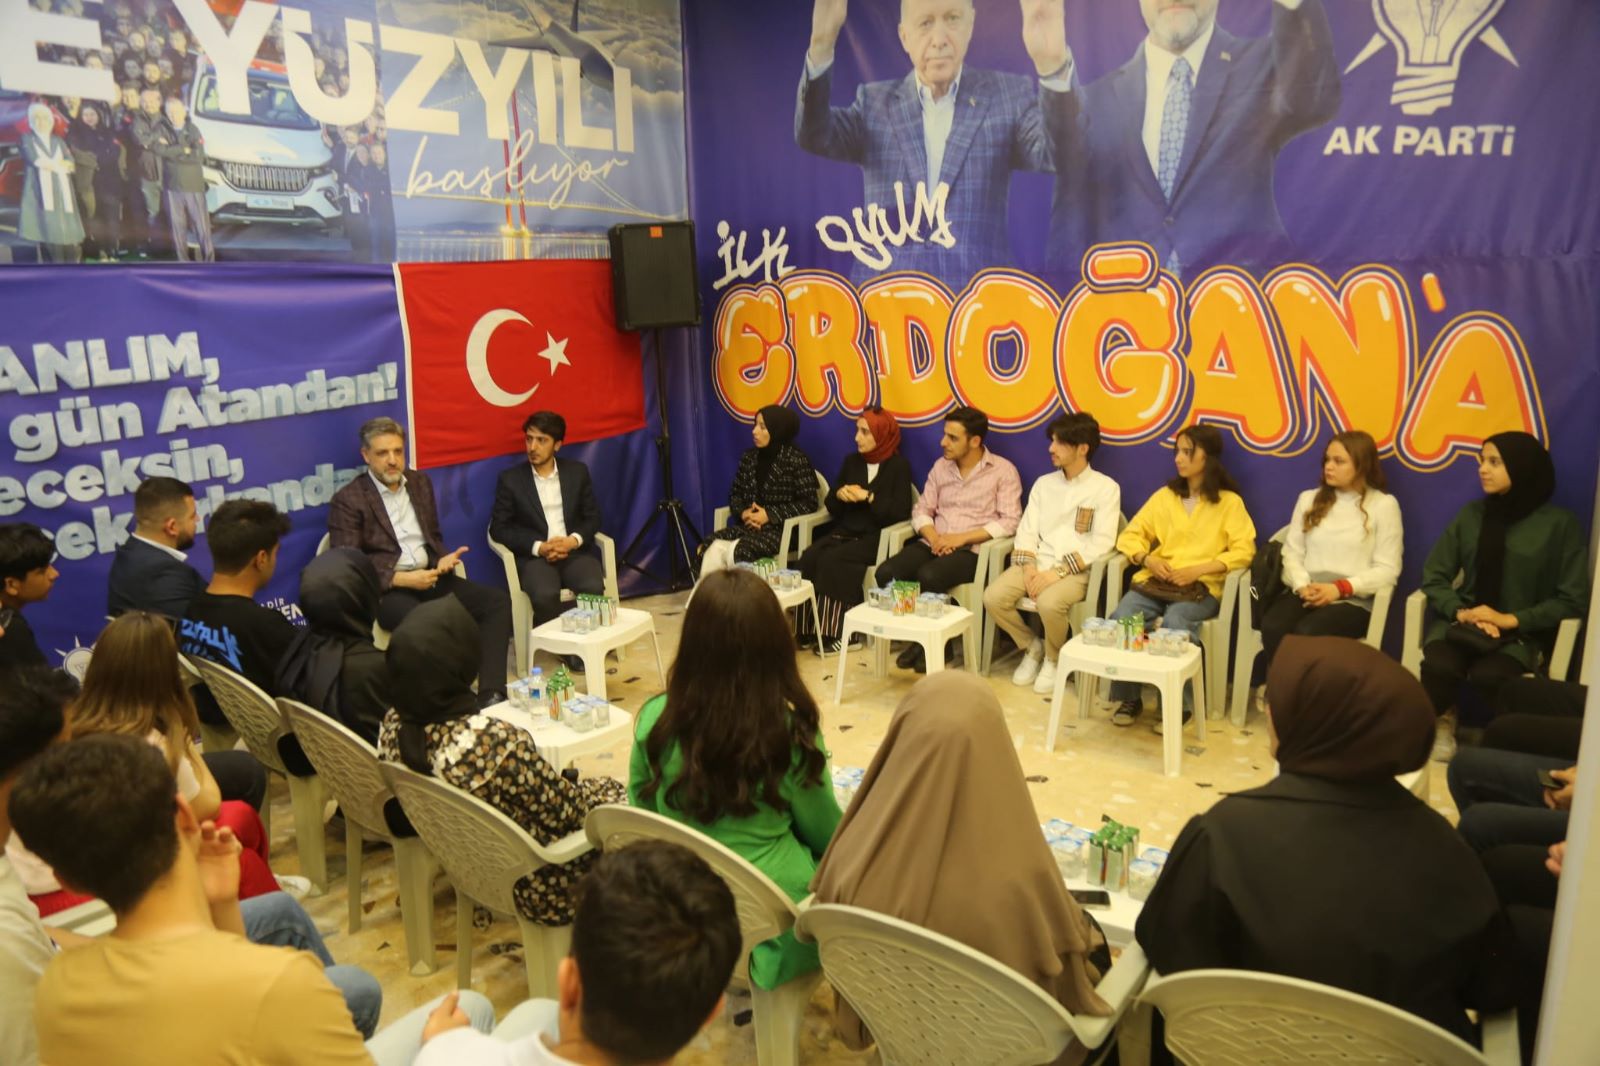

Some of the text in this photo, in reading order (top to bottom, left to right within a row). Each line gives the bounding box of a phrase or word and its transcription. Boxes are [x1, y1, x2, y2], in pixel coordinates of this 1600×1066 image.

[171, 0, 635, 153] YÜZYILI
[1323, 125, 1382, 156] AK
[0, 331, 220, 396] ANLIM,
[8, 361, 399, 463] gün Atandan!
